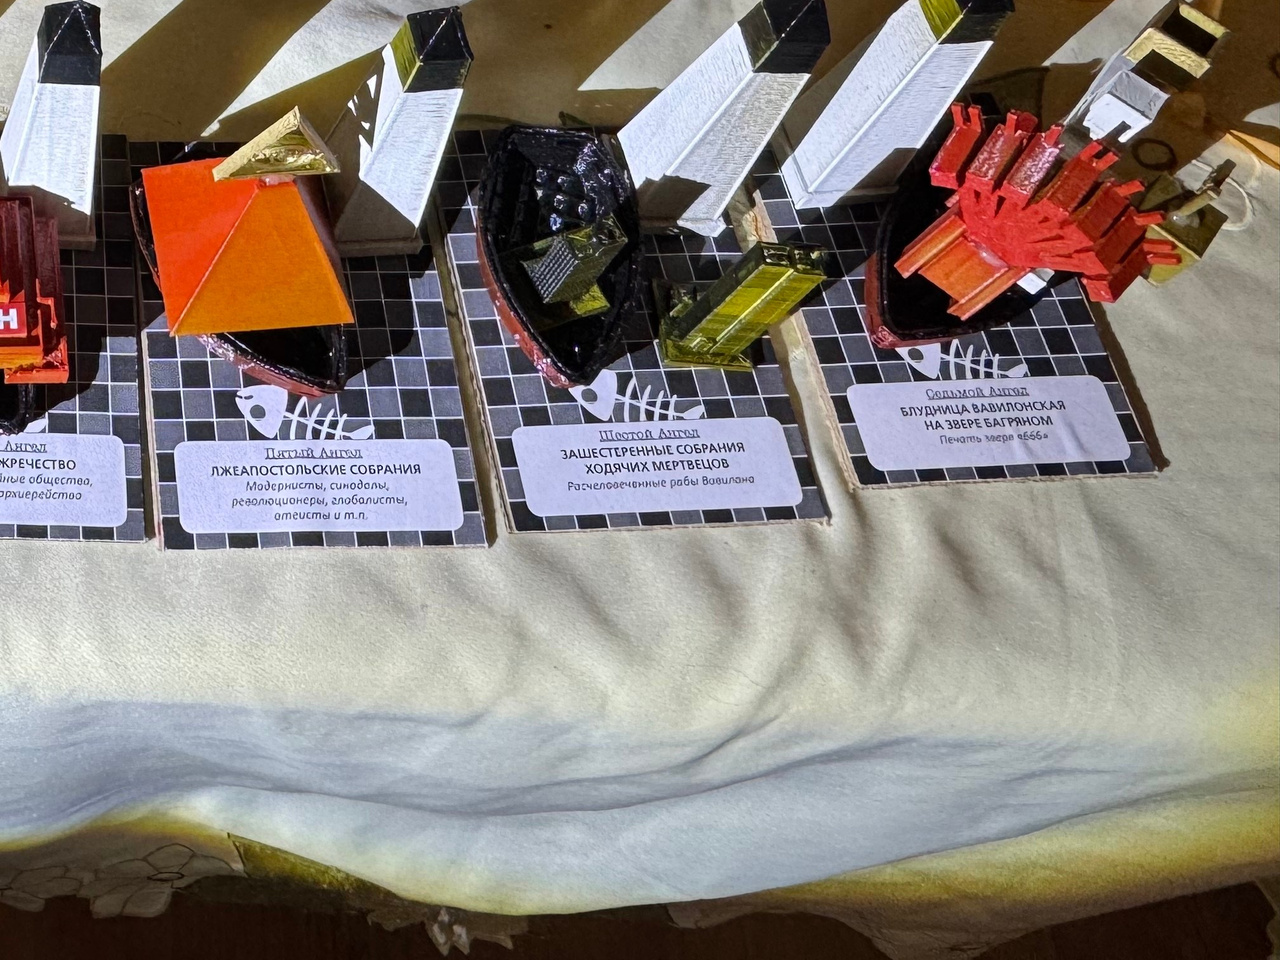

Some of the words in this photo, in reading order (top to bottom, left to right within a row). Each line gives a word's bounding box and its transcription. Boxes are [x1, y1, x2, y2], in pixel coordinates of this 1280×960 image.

[900, 403, 970, 418] БЛУДНИЦА
[972, 400, 1067, 415] ВАВИЛОНСКАЯ
[924, 419, 945, 431] НА
[946, 417, 983, 430] ЗВЕРЕ
[983, 415, 1054, 429] БАГРЯНОМ
[560, 444, 674, 460] ЗАШЕСТЕРЕННЫЕ
[676, 441, 746, 456] СОБРАНИЯ
[210, 464, 347, 478] ЛЖЕАПОСТОЛЬСКИЕ
[350, 463, 422, 476] СОБРАНИЯ
[585, 461, 650, 476] ХОДЯЧИХ
[652, 458, 730, 472] МЕРТВЕЦОВ
[28, 473, 94, 488] общества,
[245, 480, 327, 492] Модернисты,
[670, 475, 700, 489] рабы
[701, 475, 756, 487] Вавилона
[231, 495, 329, 509] революционеры,
[274, 510, 331, 522] атеисты
[334, 512, 341, 520] и
